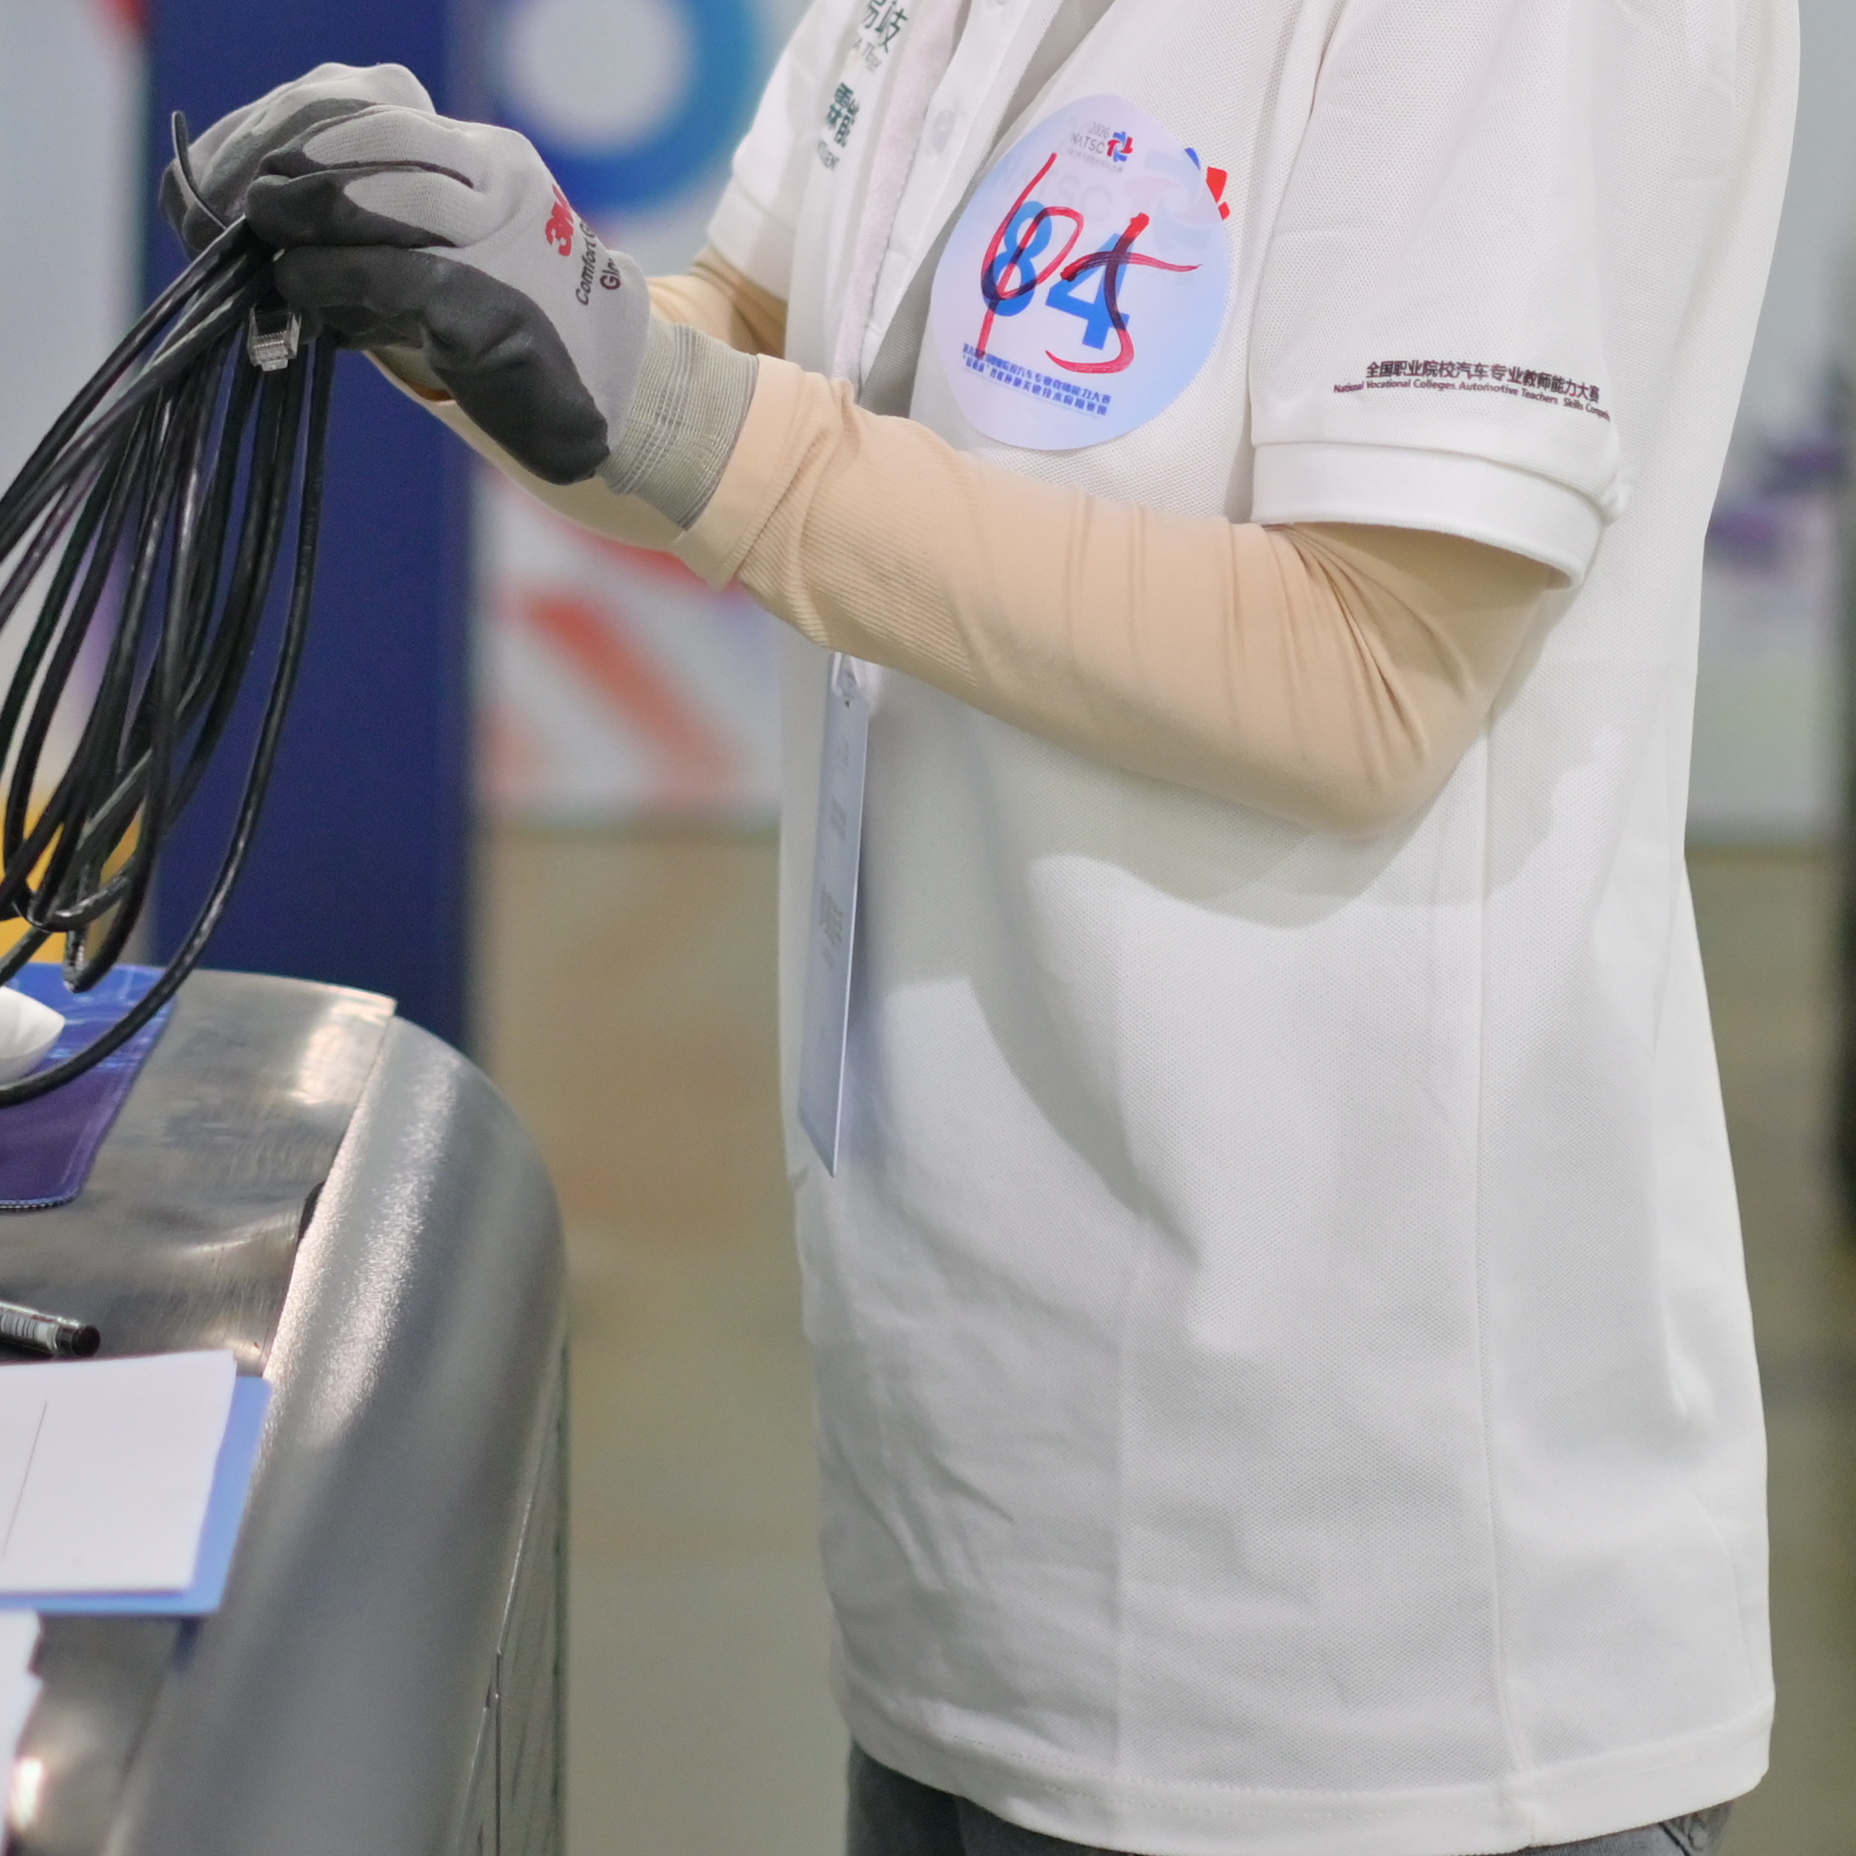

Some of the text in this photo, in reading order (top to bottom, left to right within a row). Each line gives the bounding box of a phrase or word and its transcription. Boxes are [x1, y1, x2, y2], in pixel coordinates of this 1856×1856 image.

[1070, 132, 1106, 155] NATSC
[545, 183, 575, 257] 3M
[575, 236, 597, 306] Comfort
[981, 200, 1132, 351] 84
[1333, 381, 1364, 393] National
[1366, 379, 1411, 390] Vocational
[1413, 379, 1455, 391] Colleges
[1459, 381, 1519, 396] Automotive
[1521, 387, 1558, 404] Teachers
[1563, 398, 1584, 410] Skills
[1366, 360, 1600, 404] 全国职业院校汽车专业教师能力大赛
